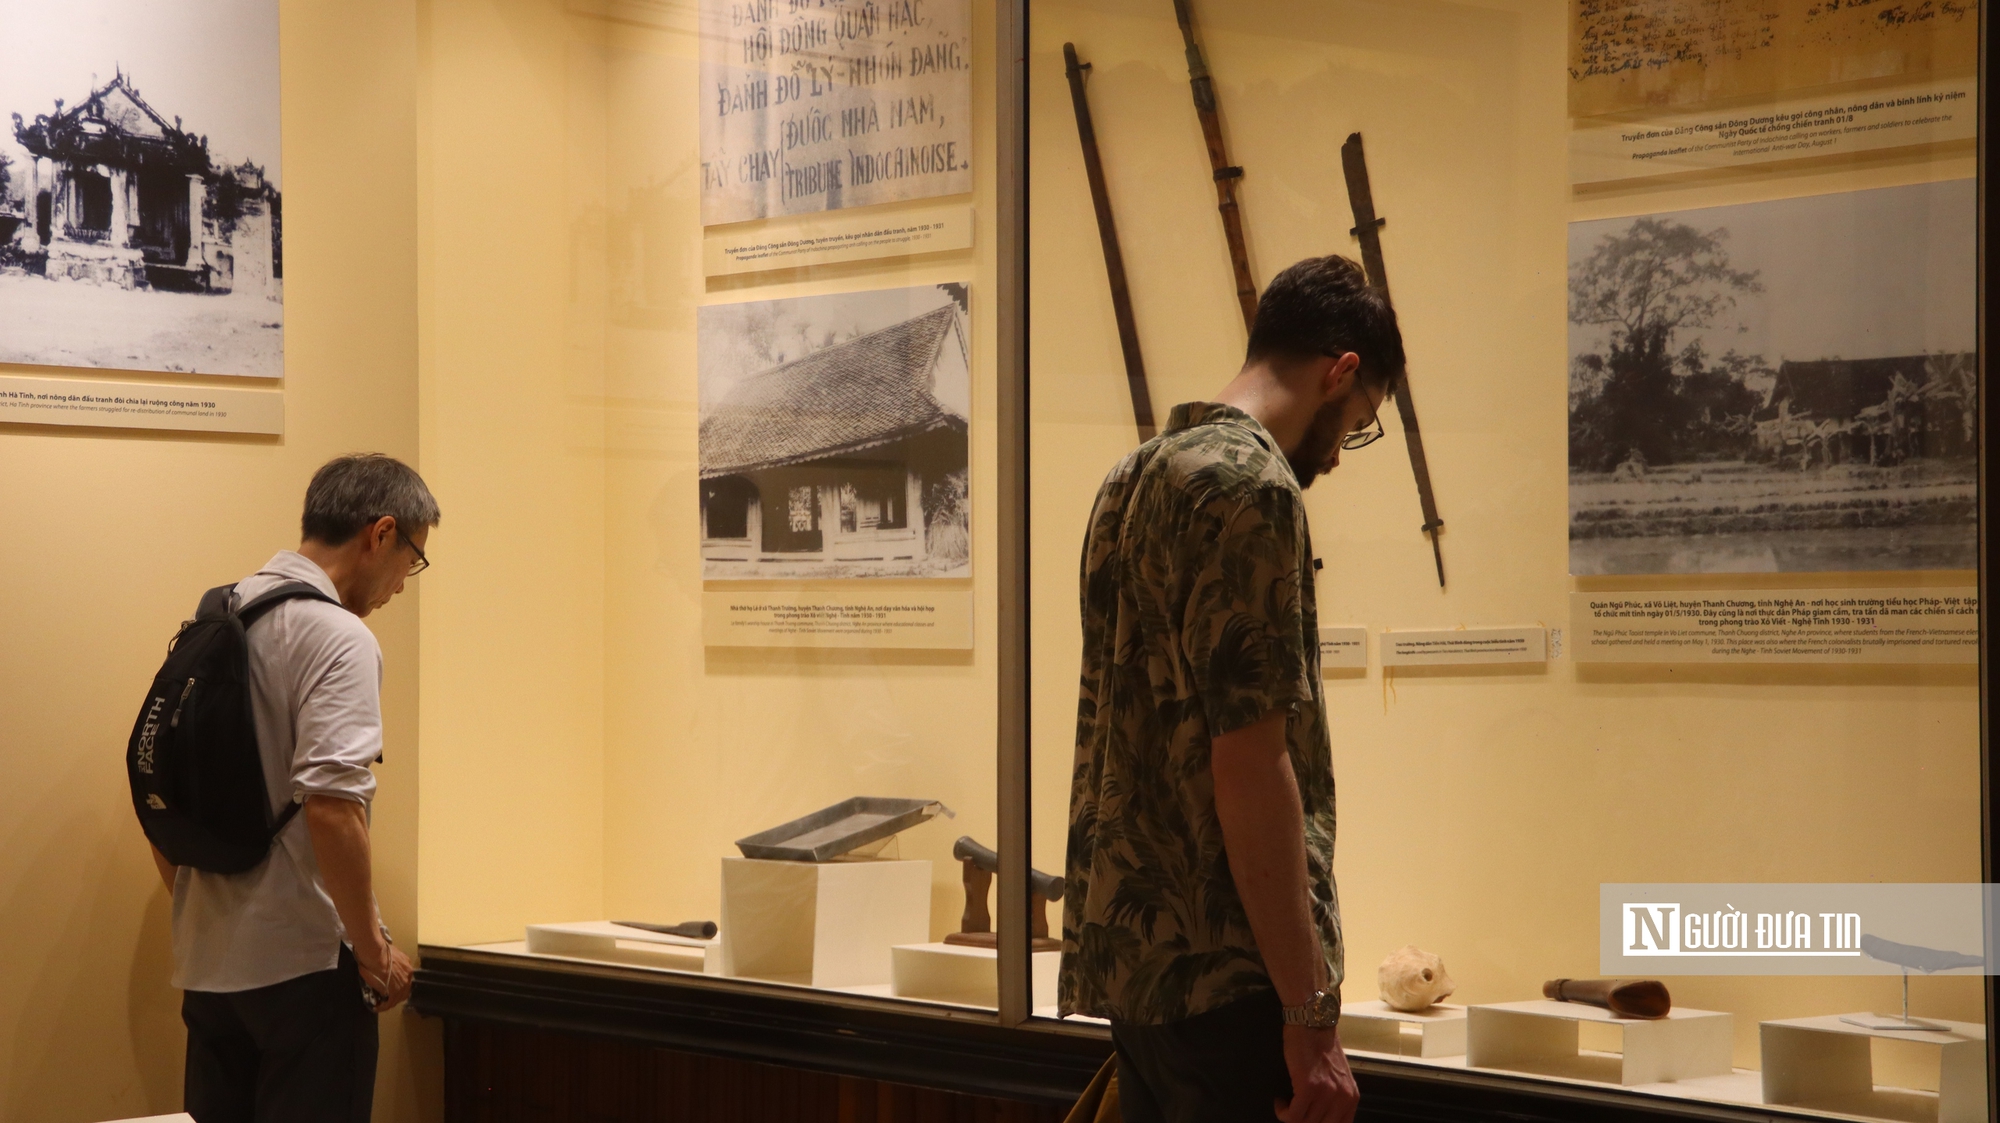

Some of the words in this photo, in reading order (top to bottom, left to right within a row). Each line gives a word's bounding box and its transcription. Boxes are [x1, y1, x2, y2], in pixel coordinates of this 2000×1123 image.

[1632, 149, 1667, 160] Propaganda
[1668, 147, 1687, 155] leaflet
[1688, 145, 1694, 153] of
[1704, 141, 1736, 151] Communist
[1753, 137, 1759, 145] of
[1760, 135, 1788, 144] Indochina
[1789, 132, 1808, 140] calling
[1881, 121, 1903, 129] soldiers
[1912, 116, 1940, 125] celebrate
[1733, 145, 1770, 156] International
[1772, 143, 1797, 151] Anti-war
[1798, 141, 1810, 149] Day,
[1812, 138, 1833, 147] August
[738, 148, 780, 184] CHAY
[785, 159, 843, 200] TRIBUNE
[99, 406, 122, 414] struggled
[137, 696, 165, 766] NORTH
[144, 722, 160, 775] FACE
